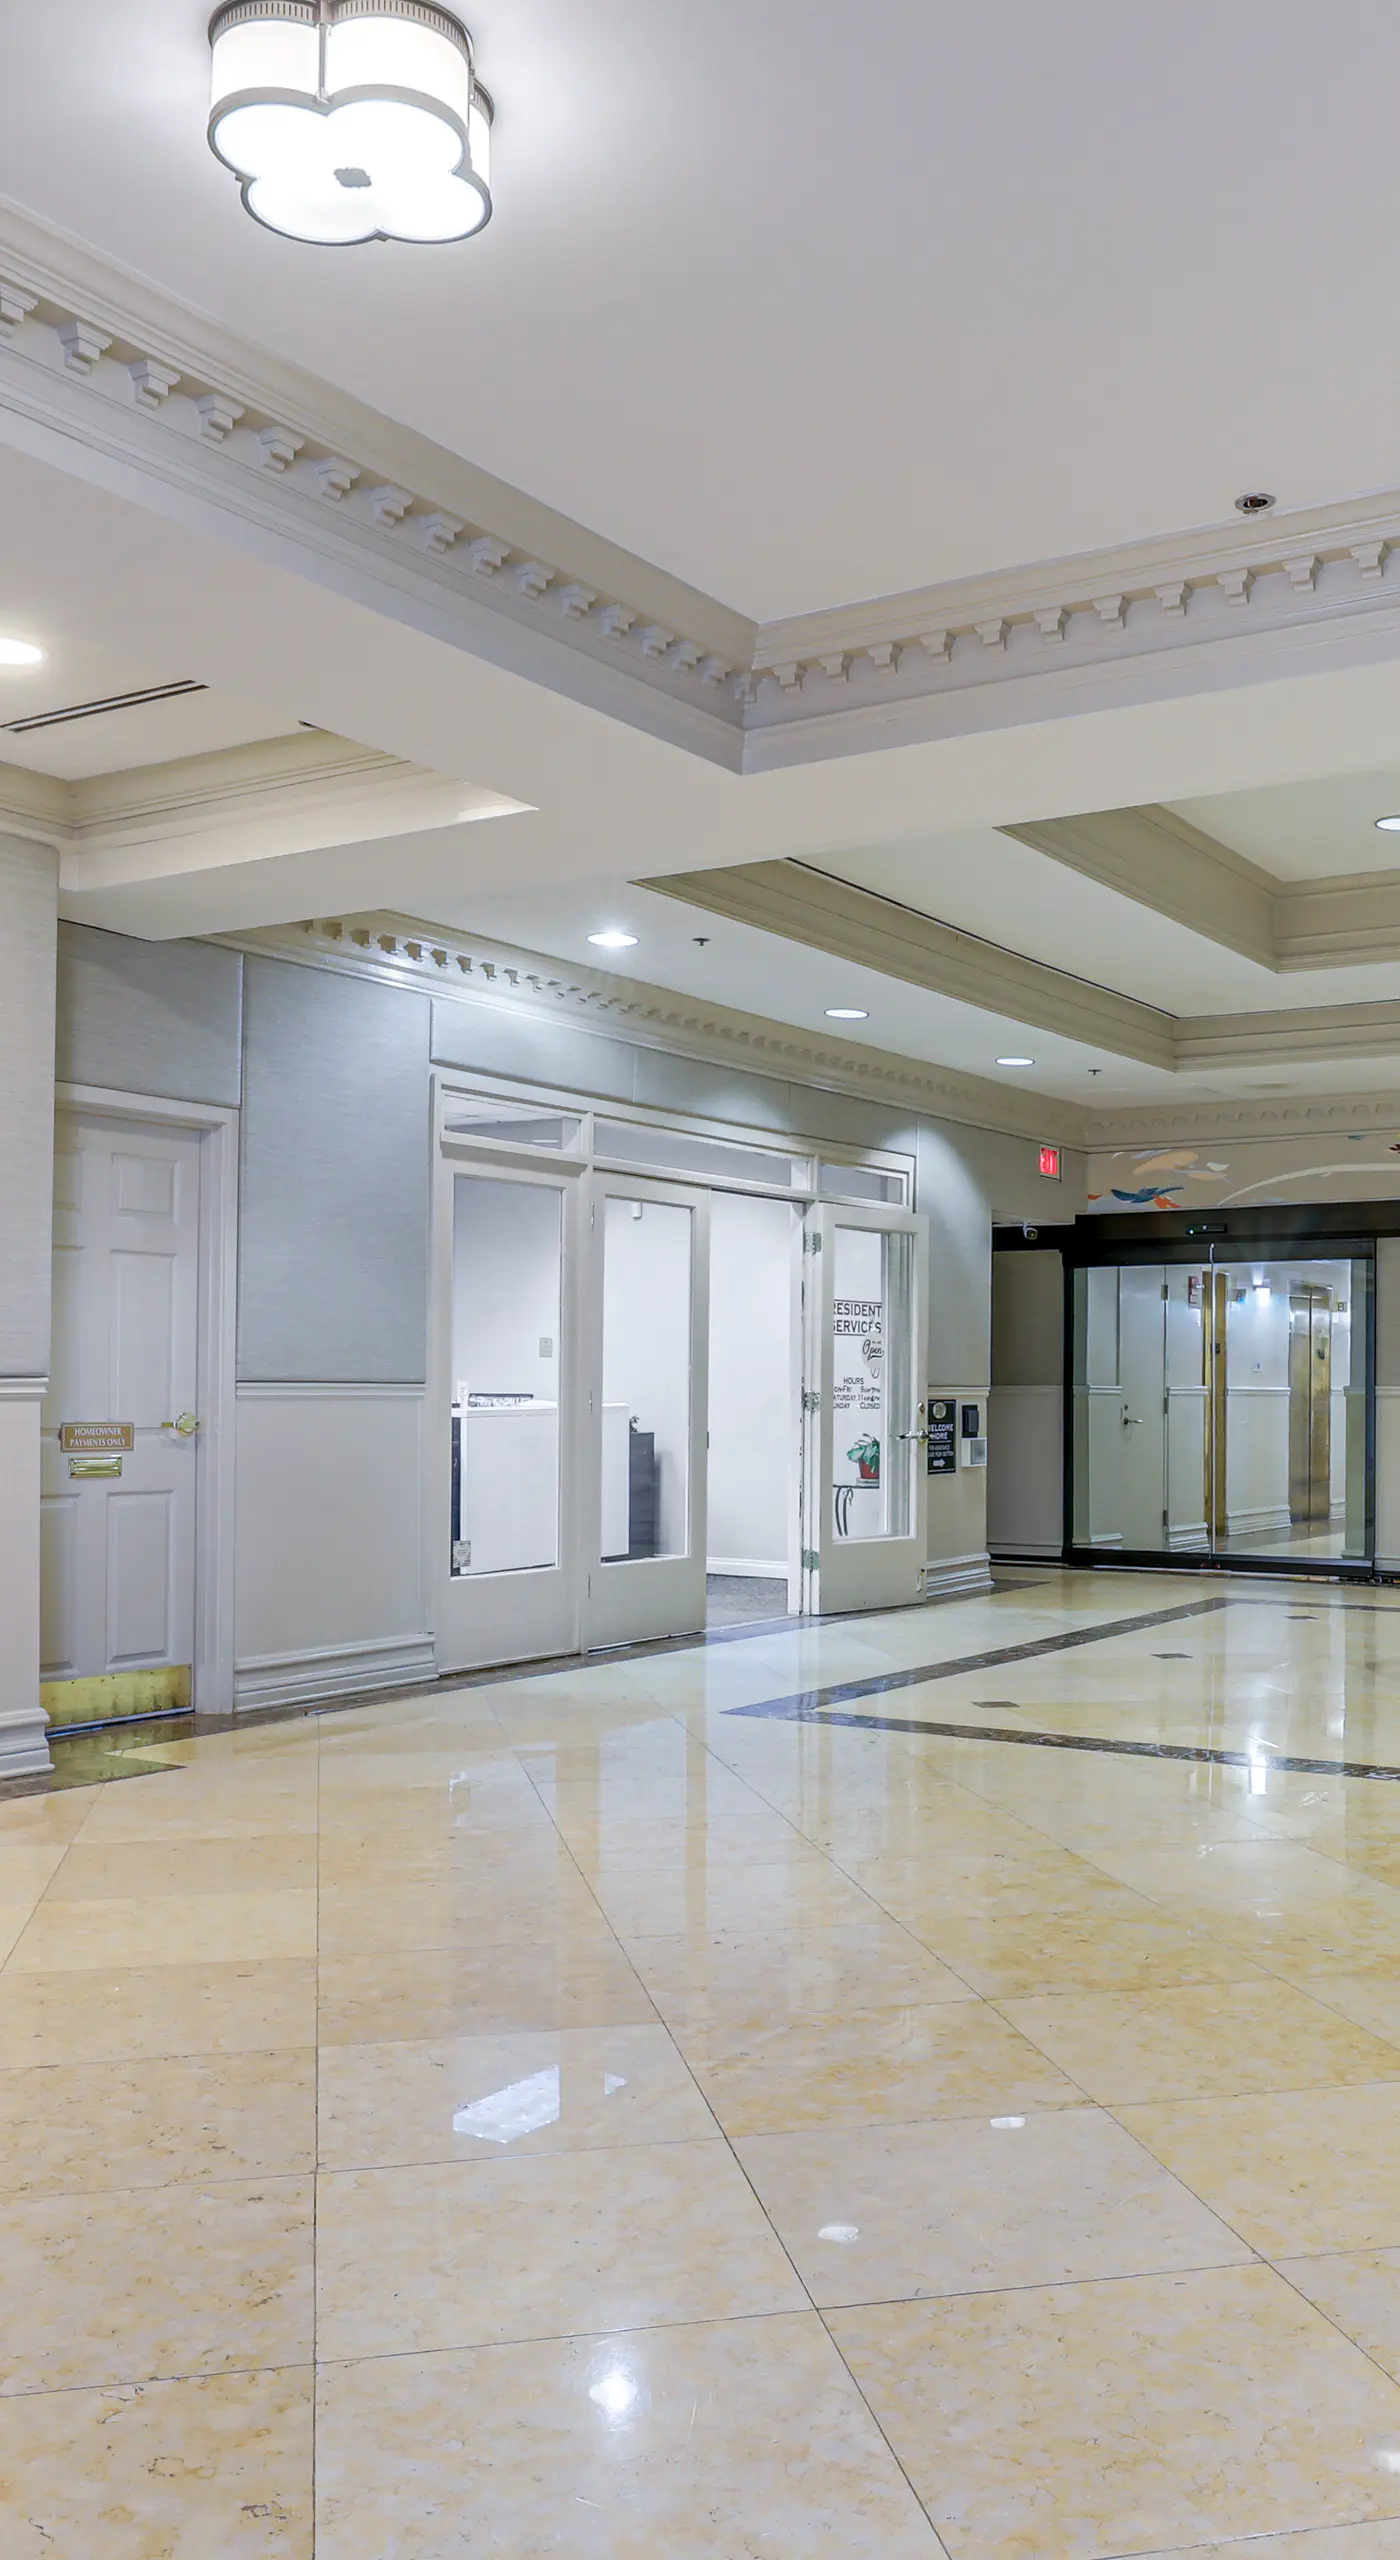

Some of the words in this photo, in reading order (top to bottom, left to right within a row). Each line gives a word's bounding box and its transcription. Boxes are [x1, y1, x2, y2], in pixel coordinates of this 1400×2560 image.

[863, 1339, 884, 1360] Open
[843, 1376, 864, 1384] HOURS
[833, 1385, 852, 1393] ON-FRI
[75, 1427, 121, 1436] HOMEOWNER
[71, 1438, 105, 1446] PAYMENTS
[107, 1438, 124, 1446] ONLY
